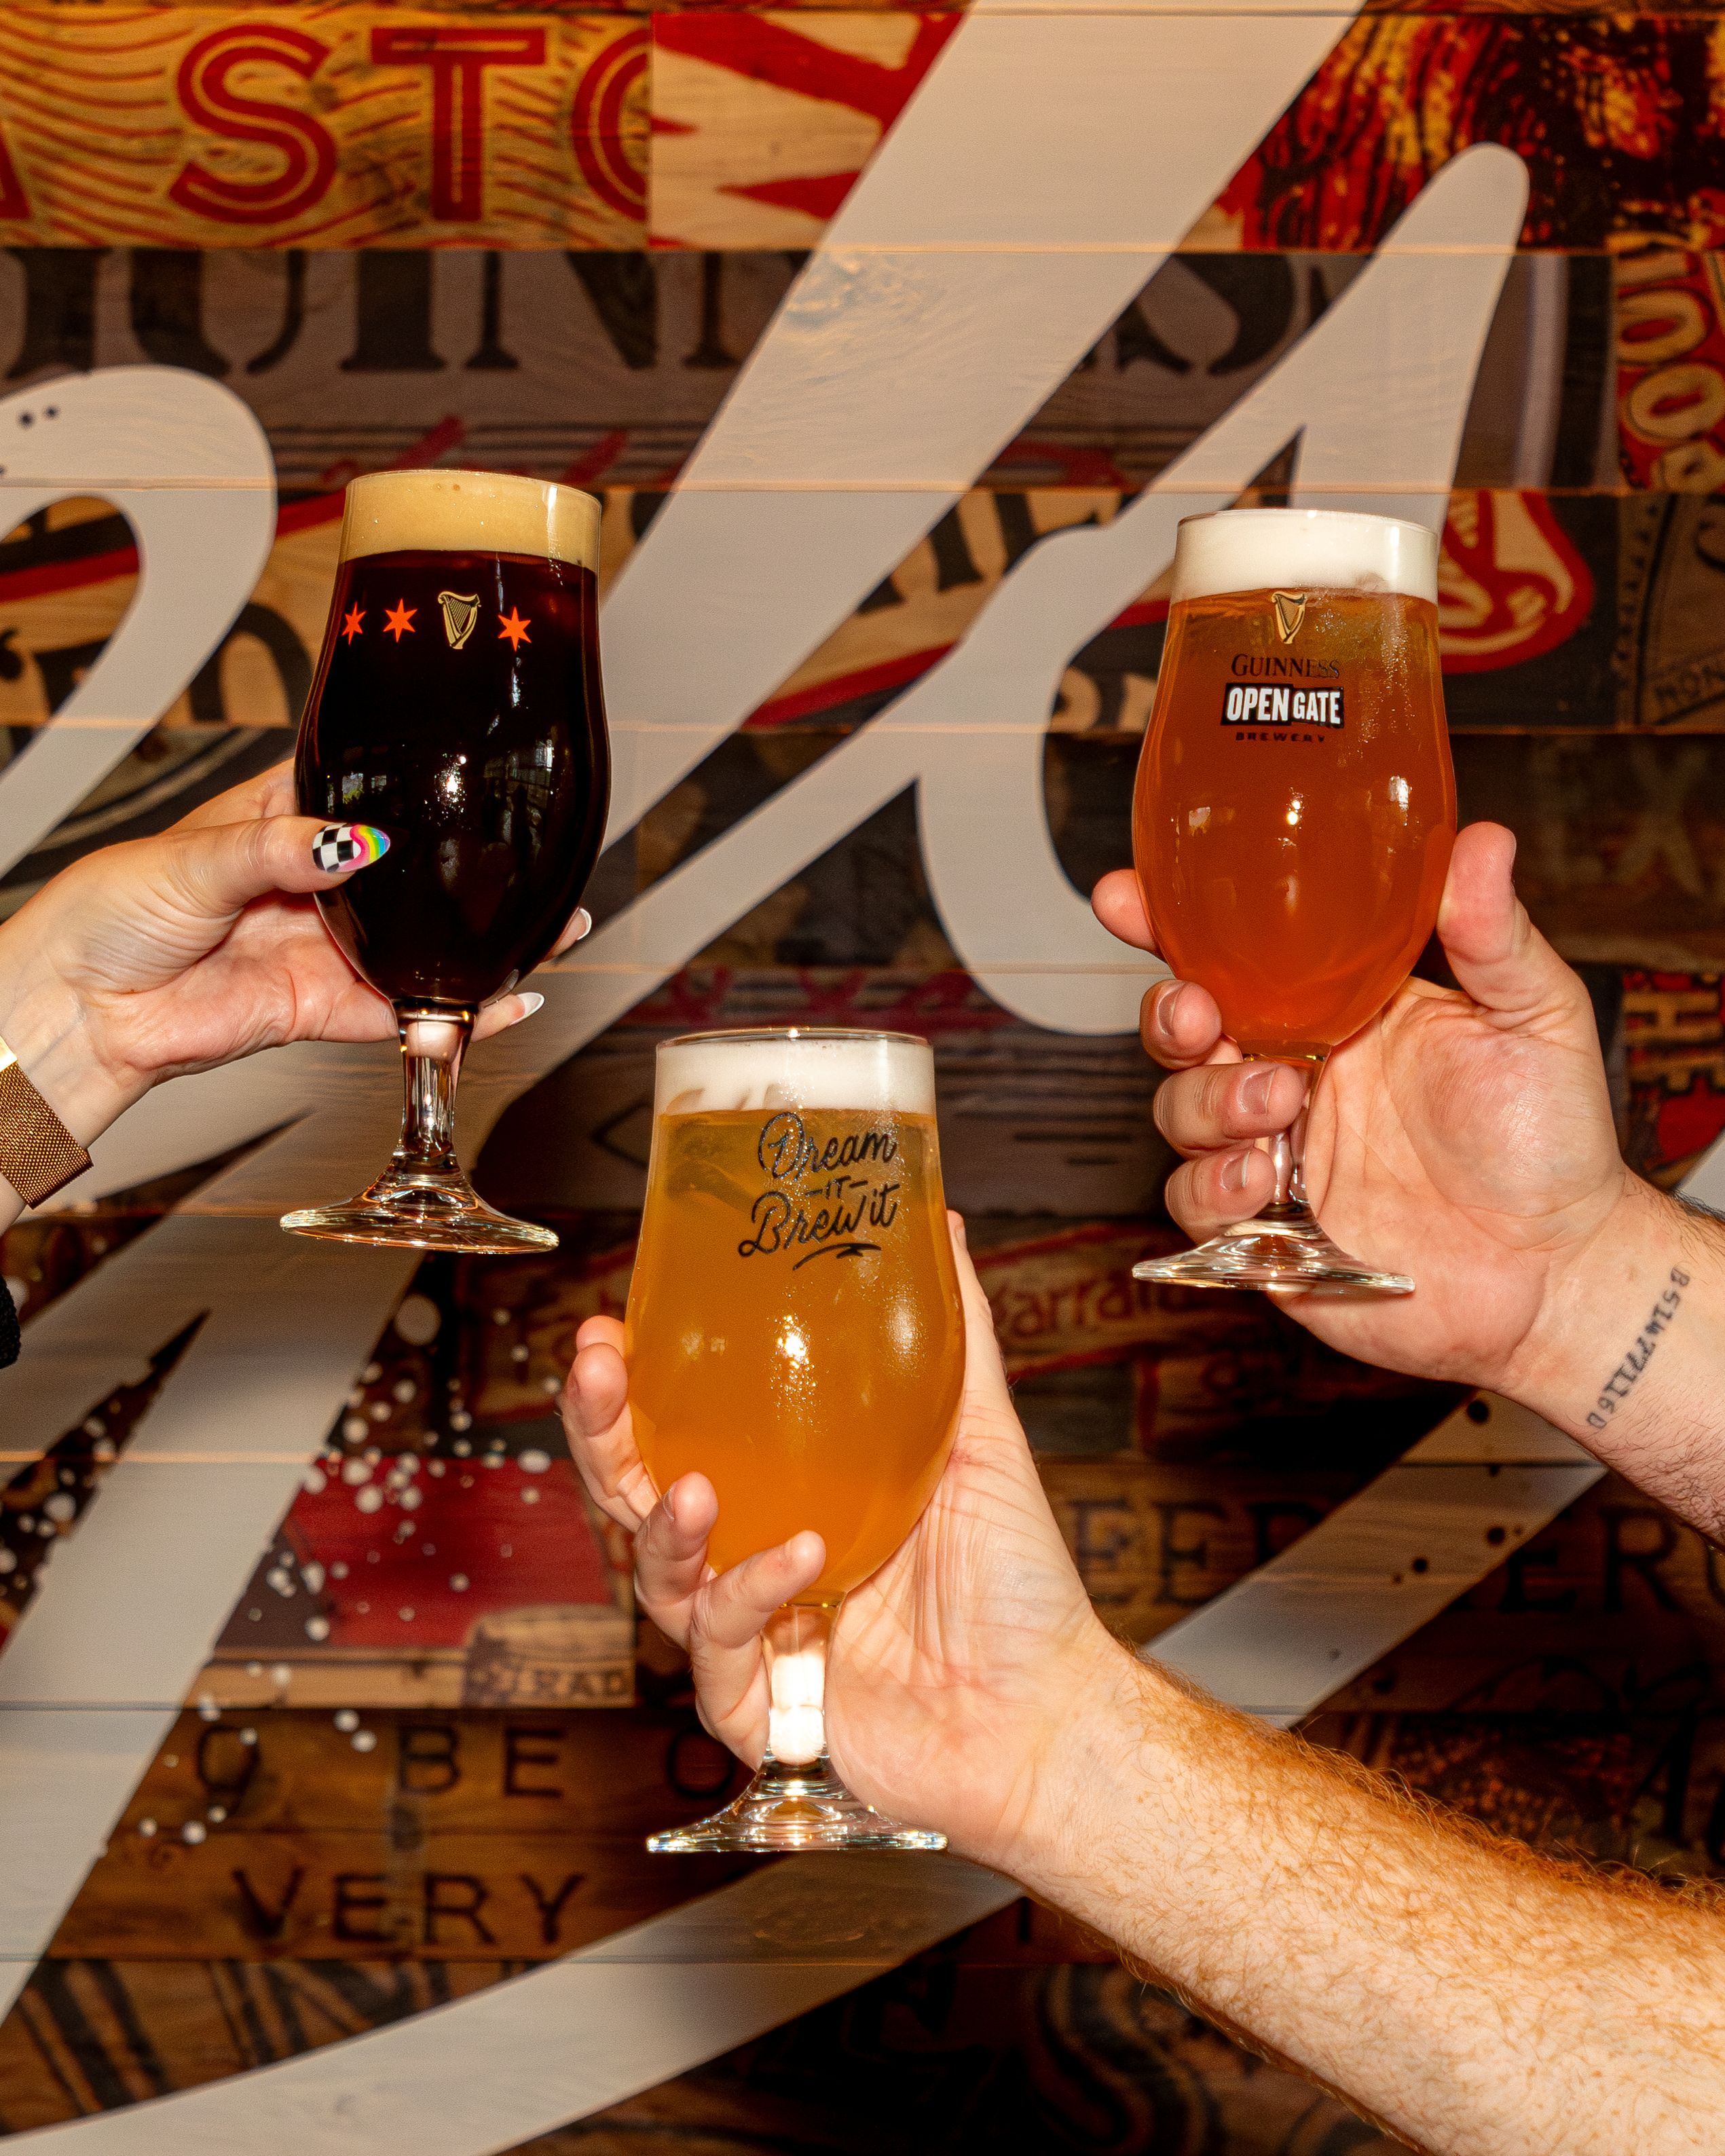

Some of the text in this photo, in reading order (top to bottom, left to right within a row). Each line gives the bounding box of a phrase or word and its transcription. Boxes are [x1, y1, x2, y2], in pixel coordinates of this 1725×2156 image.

[1231, 653, 1341, 680] GUINNESS
[1226, 687, 1341, 724] OPEN GATE
[1235, 731, 1326, 743] BREWERY
[758, 1111, 898, 1183] Dream
[738, 1191, 867, 1257] Brew
[398, 1726, 565, 1799] BE
[232, 1868, 587, 1946] VERY
